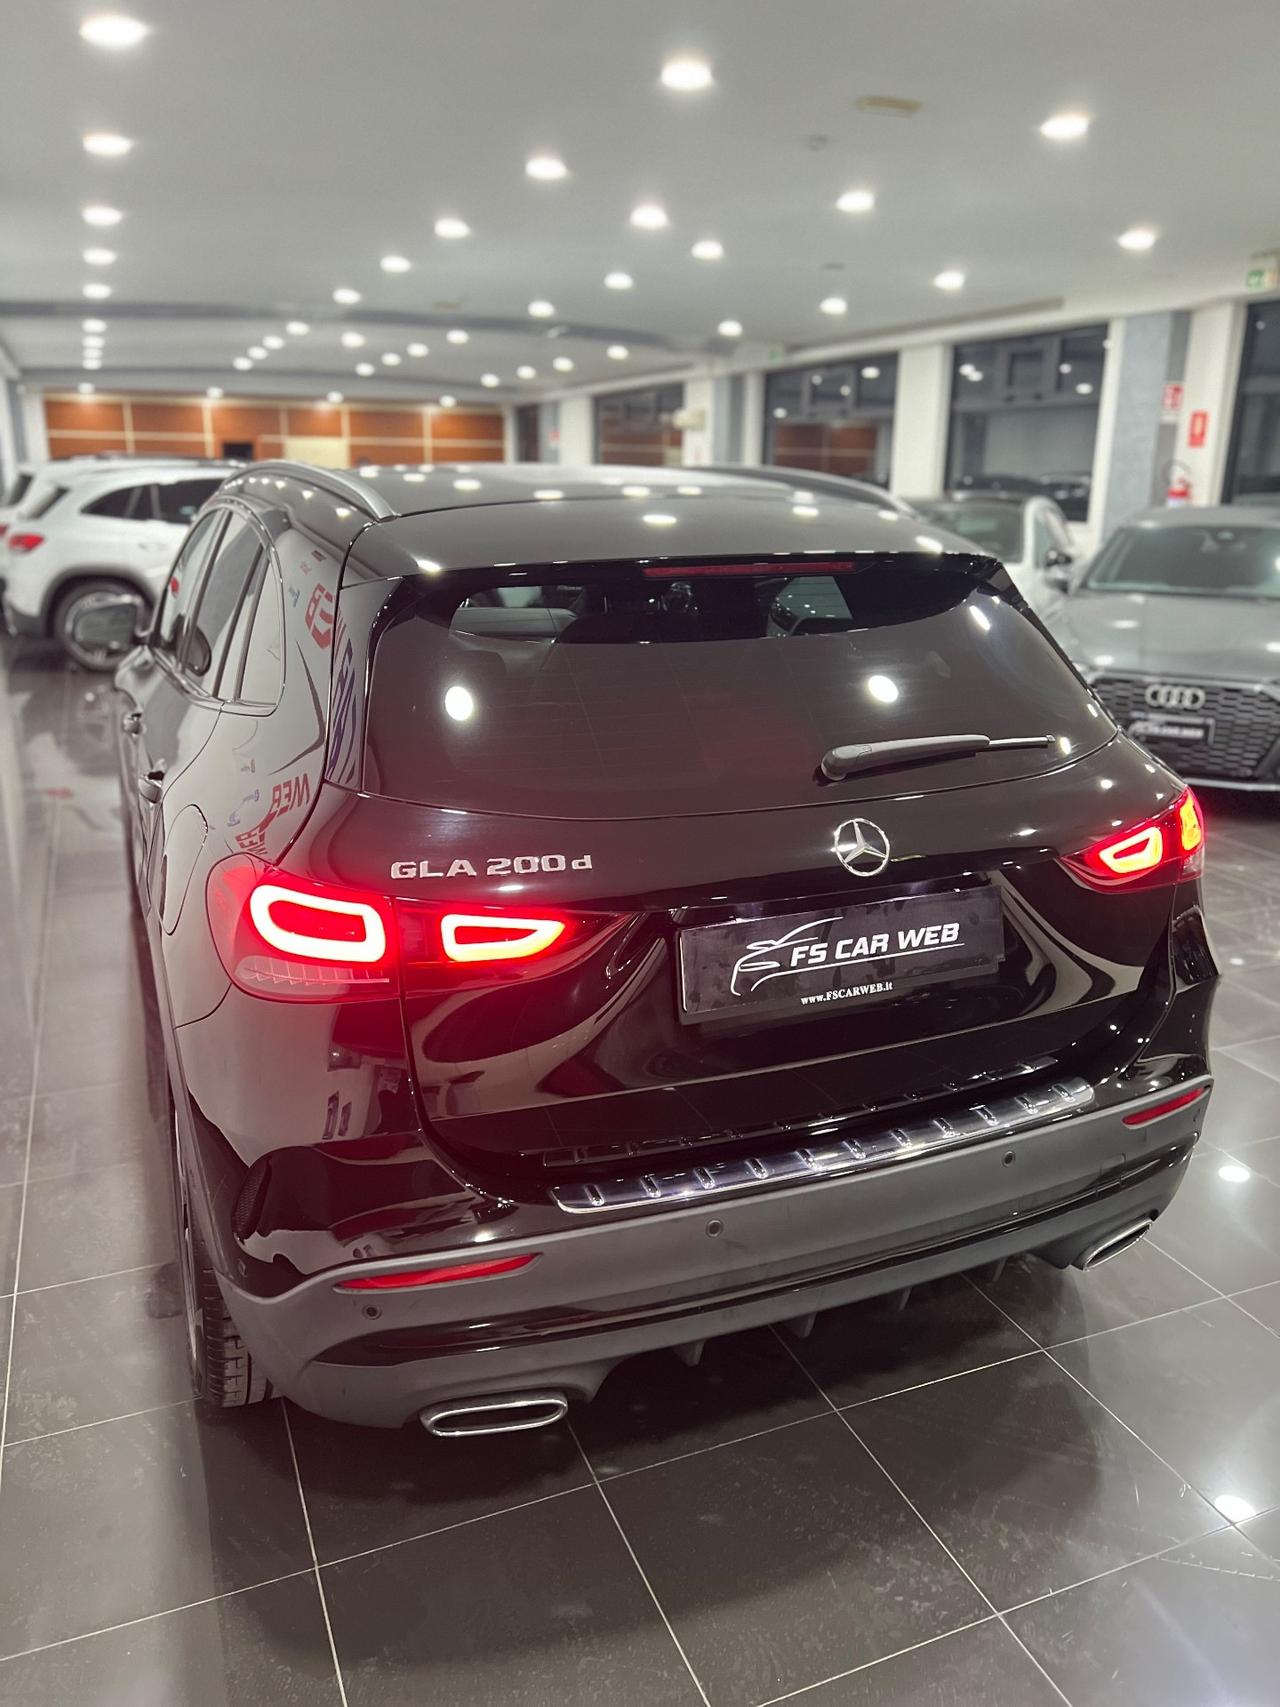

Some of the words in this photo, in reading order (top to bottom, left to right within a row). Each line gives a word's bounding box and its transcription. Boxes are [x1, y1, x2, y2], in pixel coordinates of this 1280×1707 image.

[390, 859, 477, 879] GLA
[790, 943, 828, 967] FS
[835, 934, 889, 960] CAR
[898, 923, 960, 949] WEB
